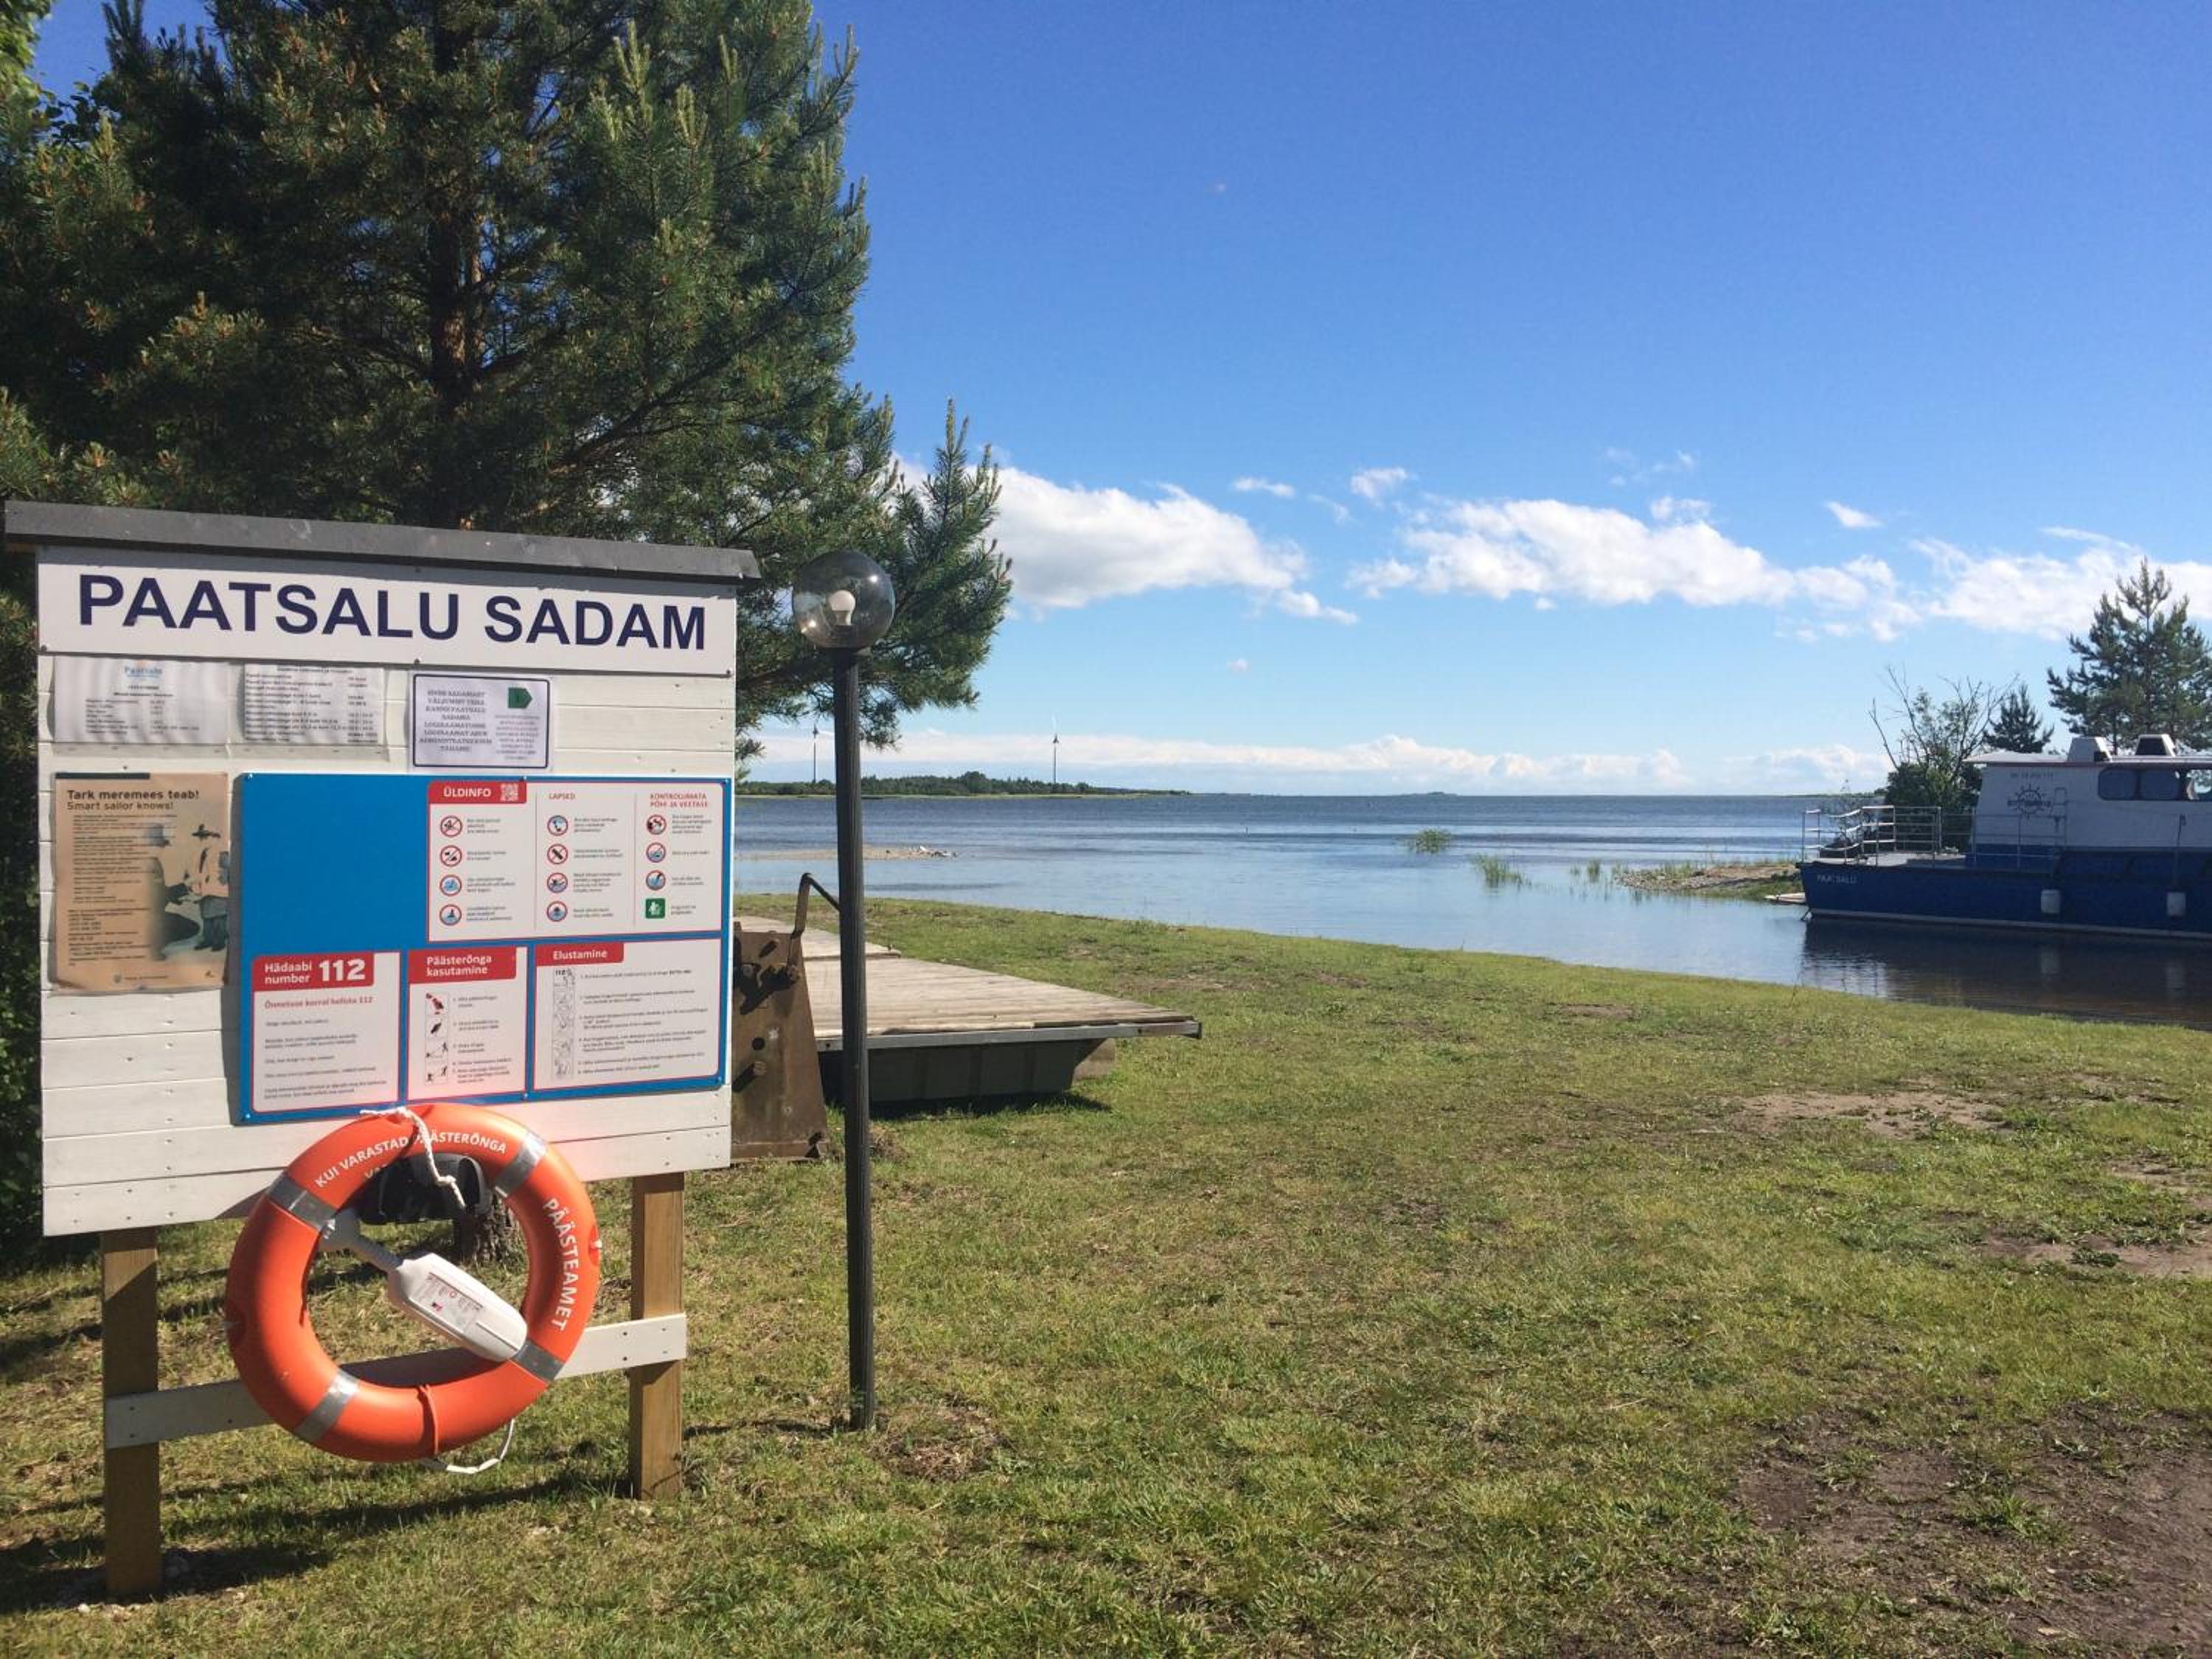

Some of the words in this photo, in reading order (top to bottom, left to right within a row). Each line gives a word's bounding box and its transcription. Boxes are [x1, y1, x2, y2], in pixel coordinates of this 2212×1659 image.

[80, 574, 459, 640] PAATSALU
[484, 595, 705, 650] SADAM
[67, 790, 94, 800] Tark
[100, 791, 164, 800] meremees
[168, 790, 199, 800] teab!
[443, 787, 491, 798] ÜLDINFO
[67, 801, 100, 810] Smart
[105, 801, 133, 810] sailor
[137, 801, 173, 810] knows!
[426, 954, 492, 965] Päästerõnga
[553, 950, 608, 960] Elustamine
[265, 961, 312, 973] Hädaabi
[319, 958, 366, 981] 112
[426, 966, 487, 977] kasutamine
[265, 973, 310, 984] number
[315, 1166, 341, 1187] KUI
[339, 1136, 408, 1169] VARASTAD
[543, 1198, 578, 1331] PÄÄSTEAMET
